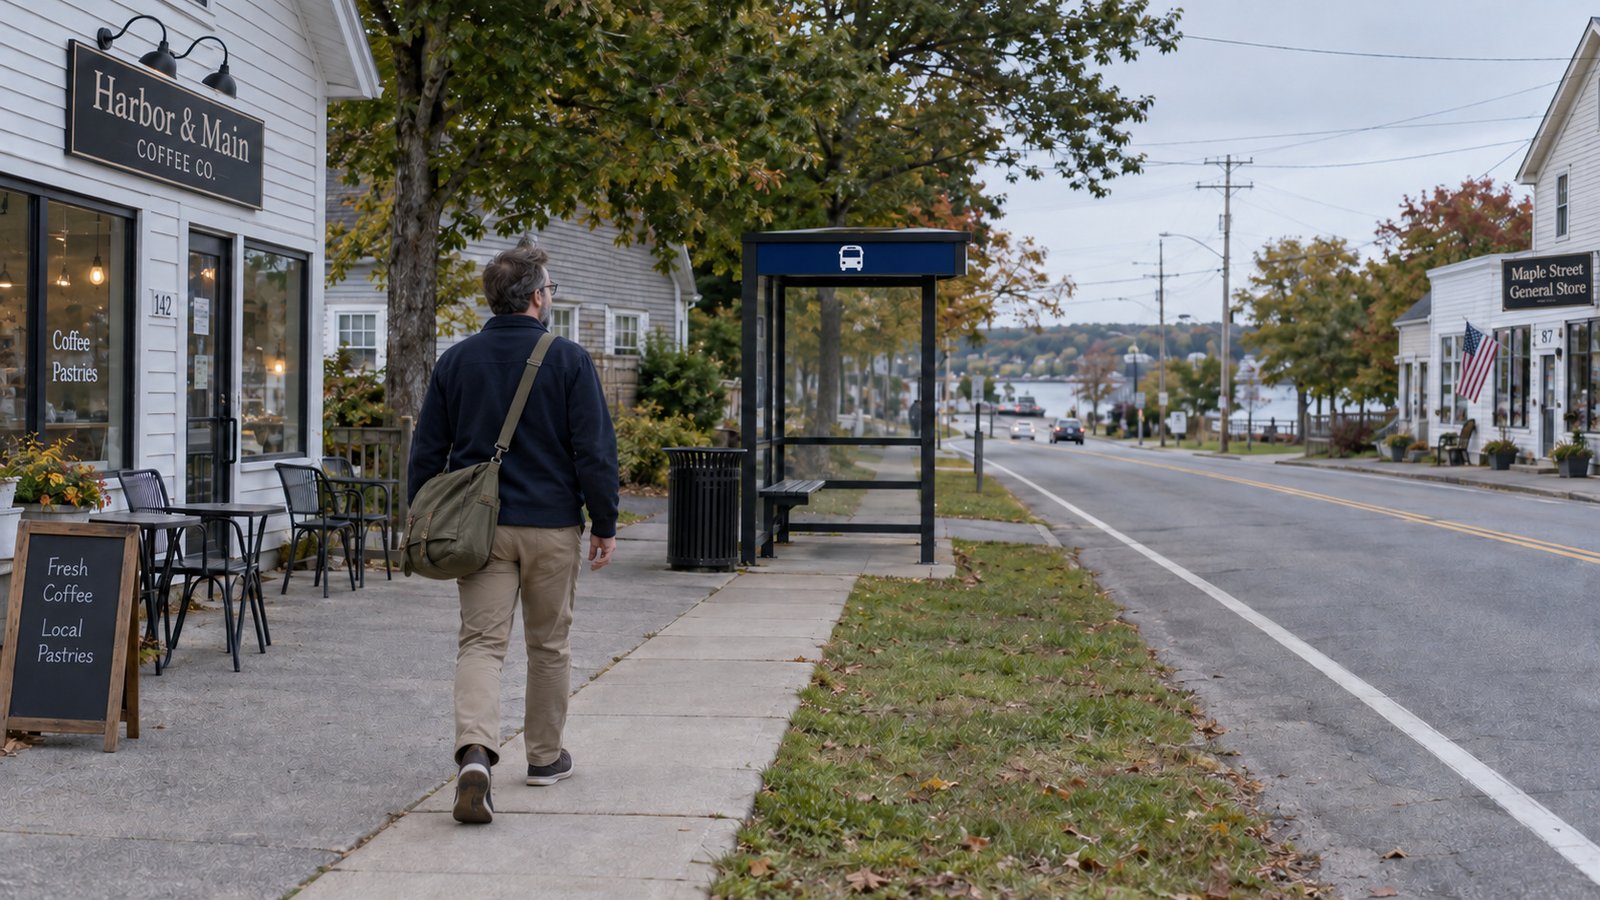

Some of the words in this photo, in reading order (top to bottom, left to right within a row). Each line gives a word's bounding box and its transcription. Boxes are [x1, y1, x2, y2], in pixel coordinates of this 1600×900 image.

[93, 69, 176, 135] Harbor
[180, 107, 196, 144] &
[200, 112, 250, 163] Main
[137, 138, 190, 172] COFFEE
[195, 158, 216, 180] CO.
[1511, 265, 1547, 283] Maple
[1549, 263, 1584, 278] Street
[1509, 282, 1554, 299] General
[1556, 281, 1587, 296] Store
[154, 293, 172, 316] 142
[52, 329, 91, 352] Coffee
[1541, 329, 1553, 343] 87
[52, 361, 98, 383] Pastries
[47, 556, 88, 577] Fresh
[43, 583, 93, 603] Coffee
[41, 617, 83, 638] Local
[37, 643, 94, 664] Pastries
